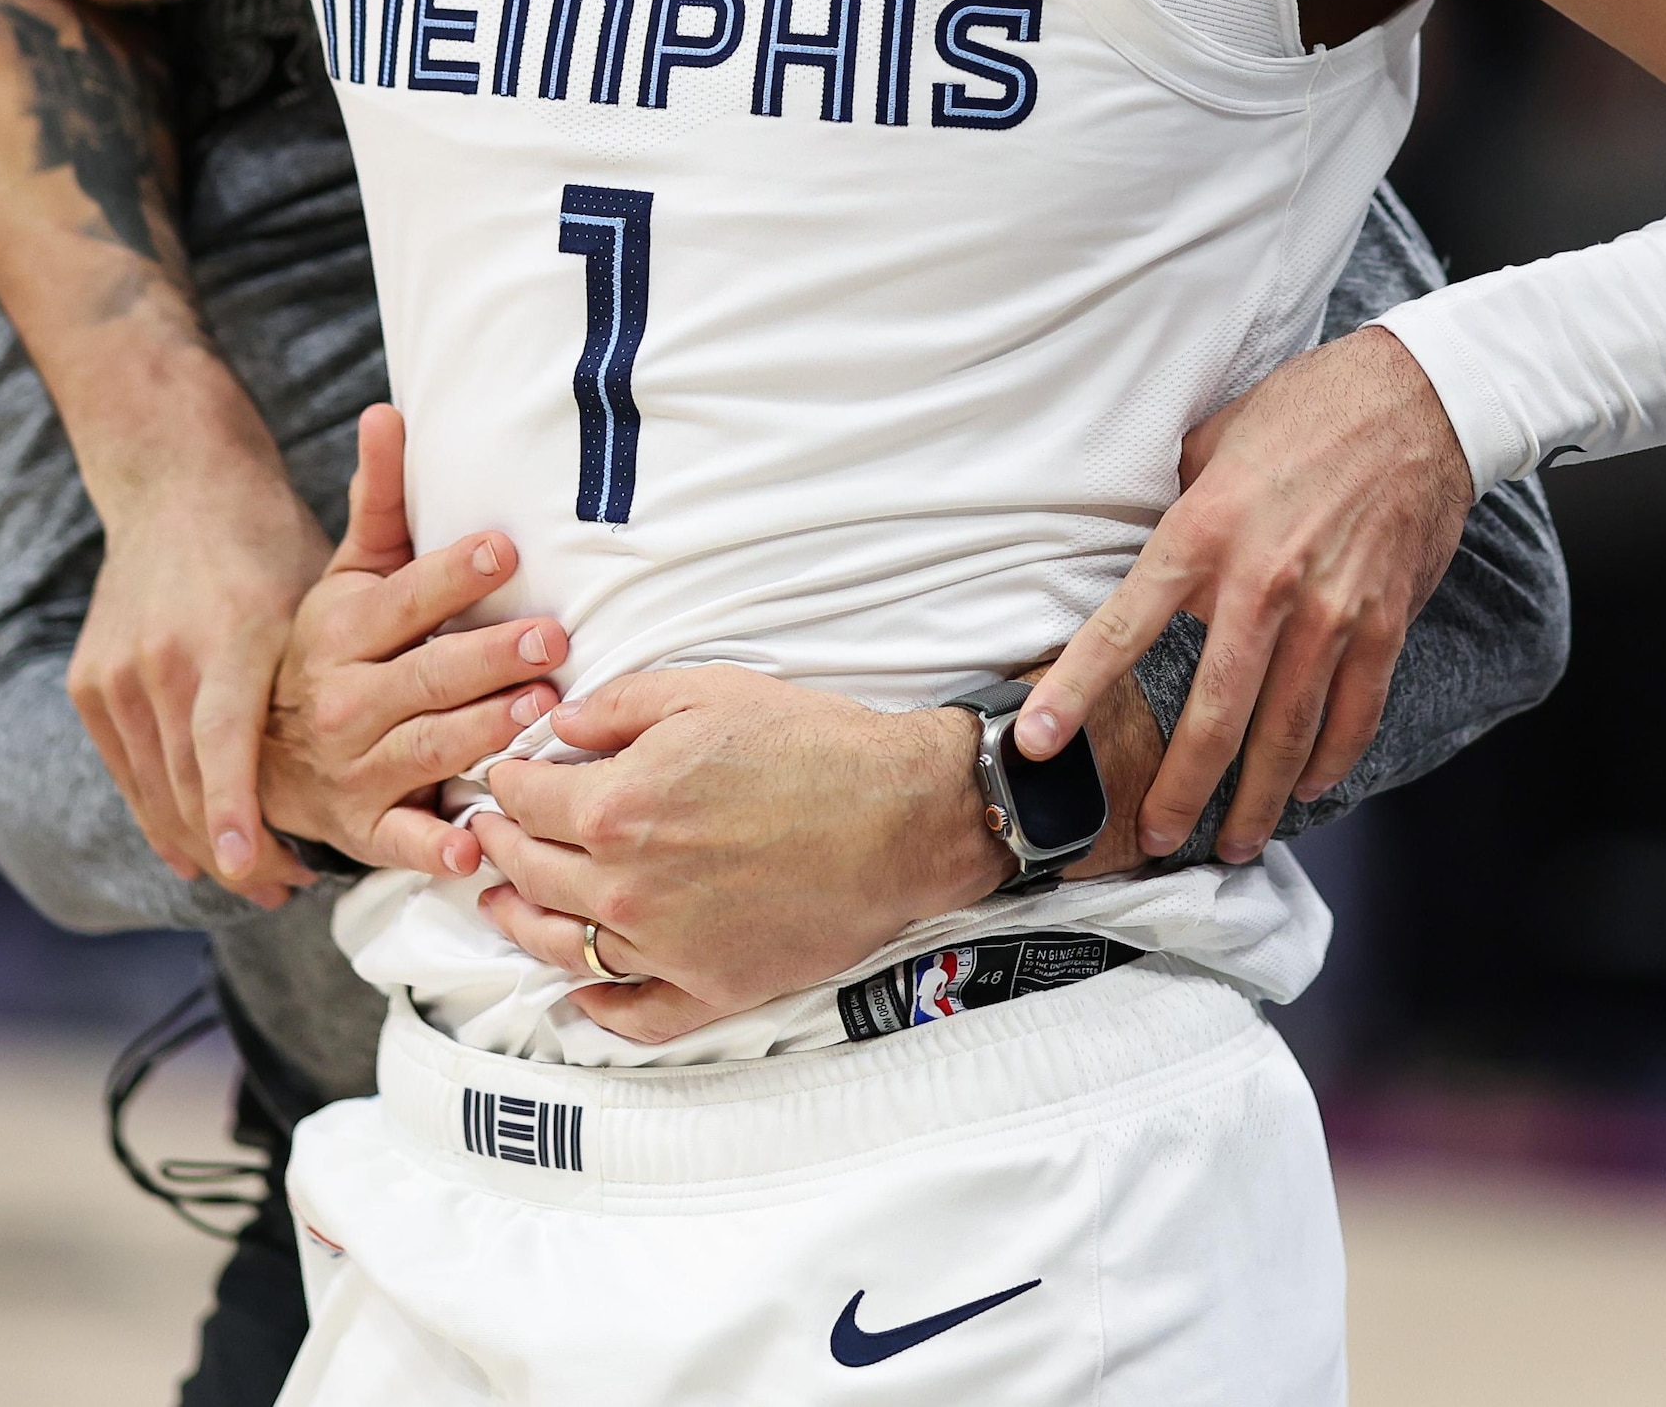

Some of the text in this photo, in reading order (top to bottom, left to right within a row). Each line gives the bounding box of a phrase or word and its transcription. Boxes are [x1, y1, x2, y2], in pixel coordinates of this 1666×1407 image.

[558, 184, 654, 524] 1
[1025, 946, 1101, 961] ENGINEERED
[976, 970, 1004, 984] 48
